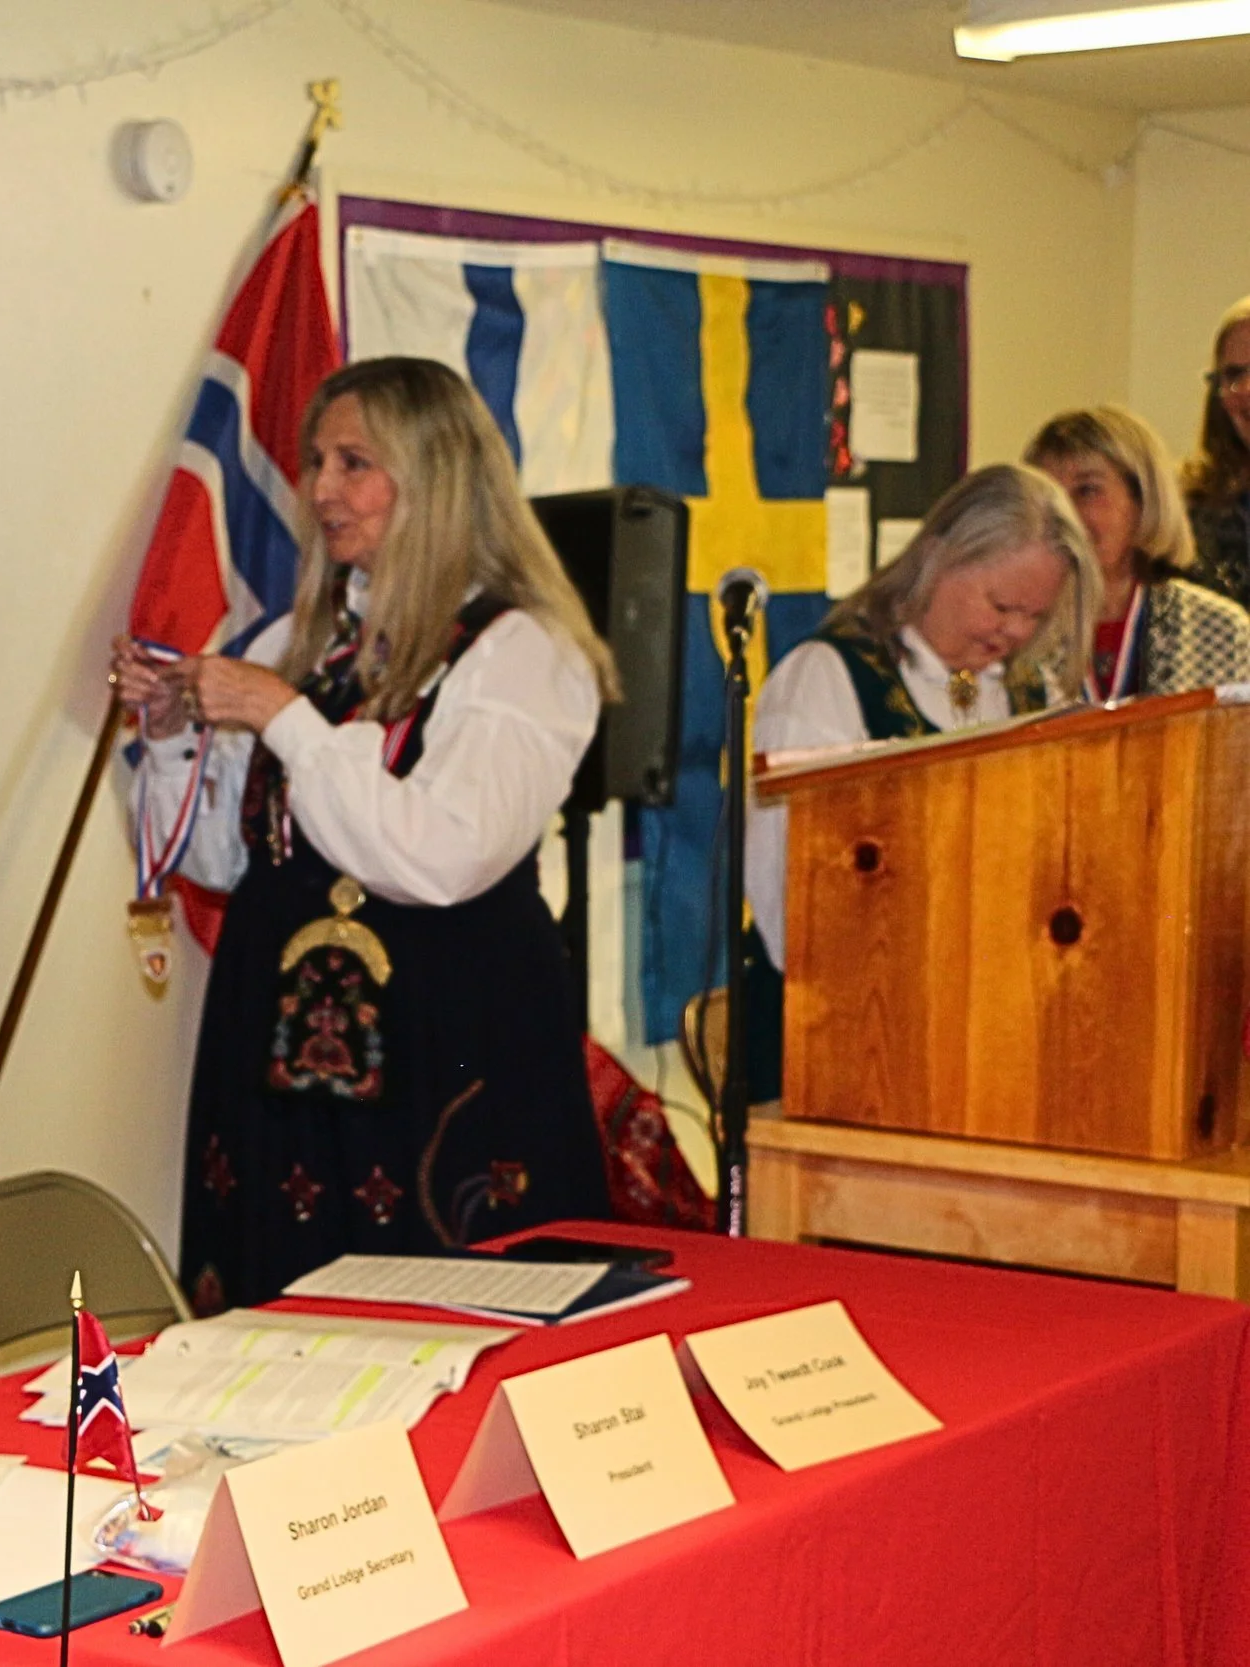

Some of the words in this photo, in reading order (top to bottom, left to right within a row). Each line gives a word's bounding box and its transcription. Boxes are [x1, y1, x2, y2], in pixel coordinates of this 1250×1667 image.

[573, 1415, 620, 1439] Sharon
[608, 1460, 653, 1482] President
[288, 1512, 339, 1540] Sharon
[342, 1495, 388, 1522] Jordan
[297, 1576, 331, 1600] Grand
[331, 1568, 364, 1587] Lodge
[365, 1549, 415, 1574] Secretary
